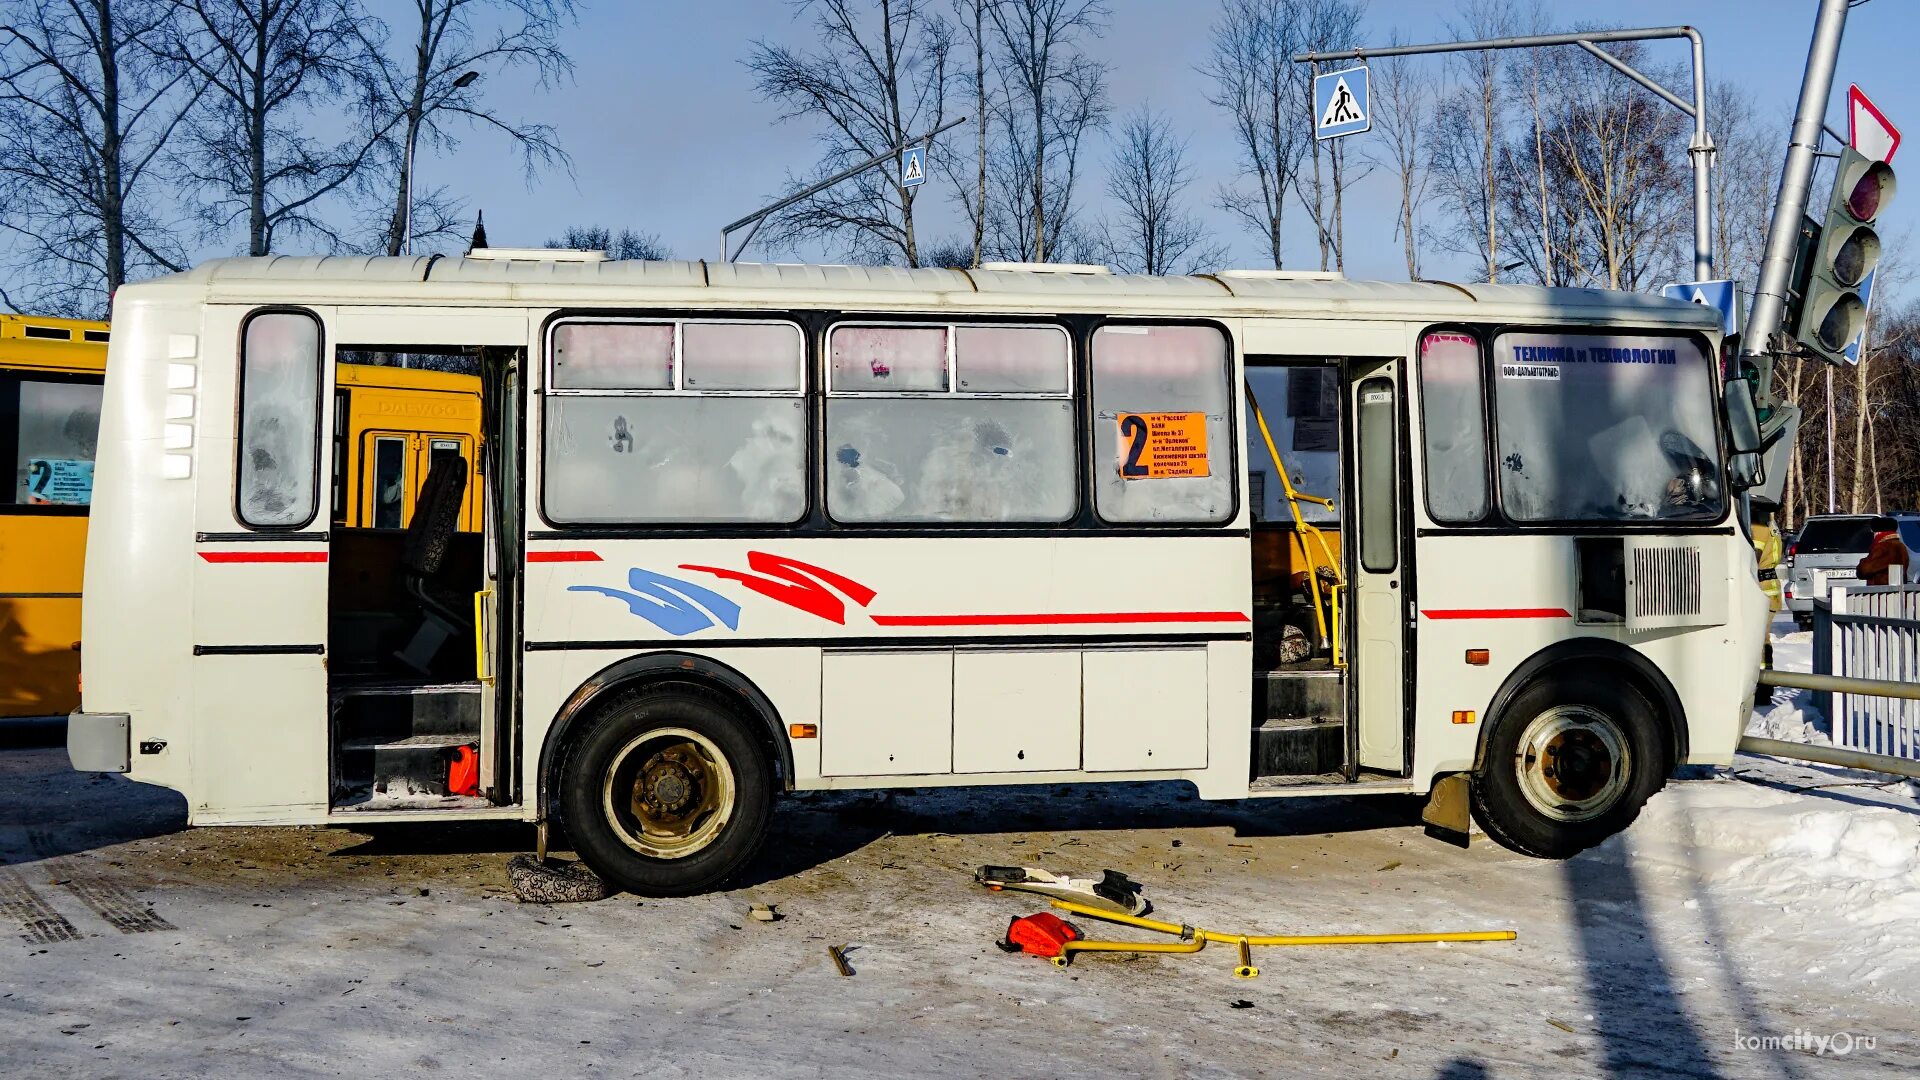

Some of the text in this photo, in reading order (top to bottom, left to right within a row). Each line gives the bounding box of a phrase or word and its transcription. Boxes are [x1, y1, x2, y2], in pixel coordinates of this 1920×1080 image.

[1513, 346, 1676, 365] ТЕХНИКА и ТЕХНОЛОГИИ
[1503, 366, 1515, 376] ООО
[378, 402, 459, 416] DAEWOO
[1121, 415, 1149, 476] 2
